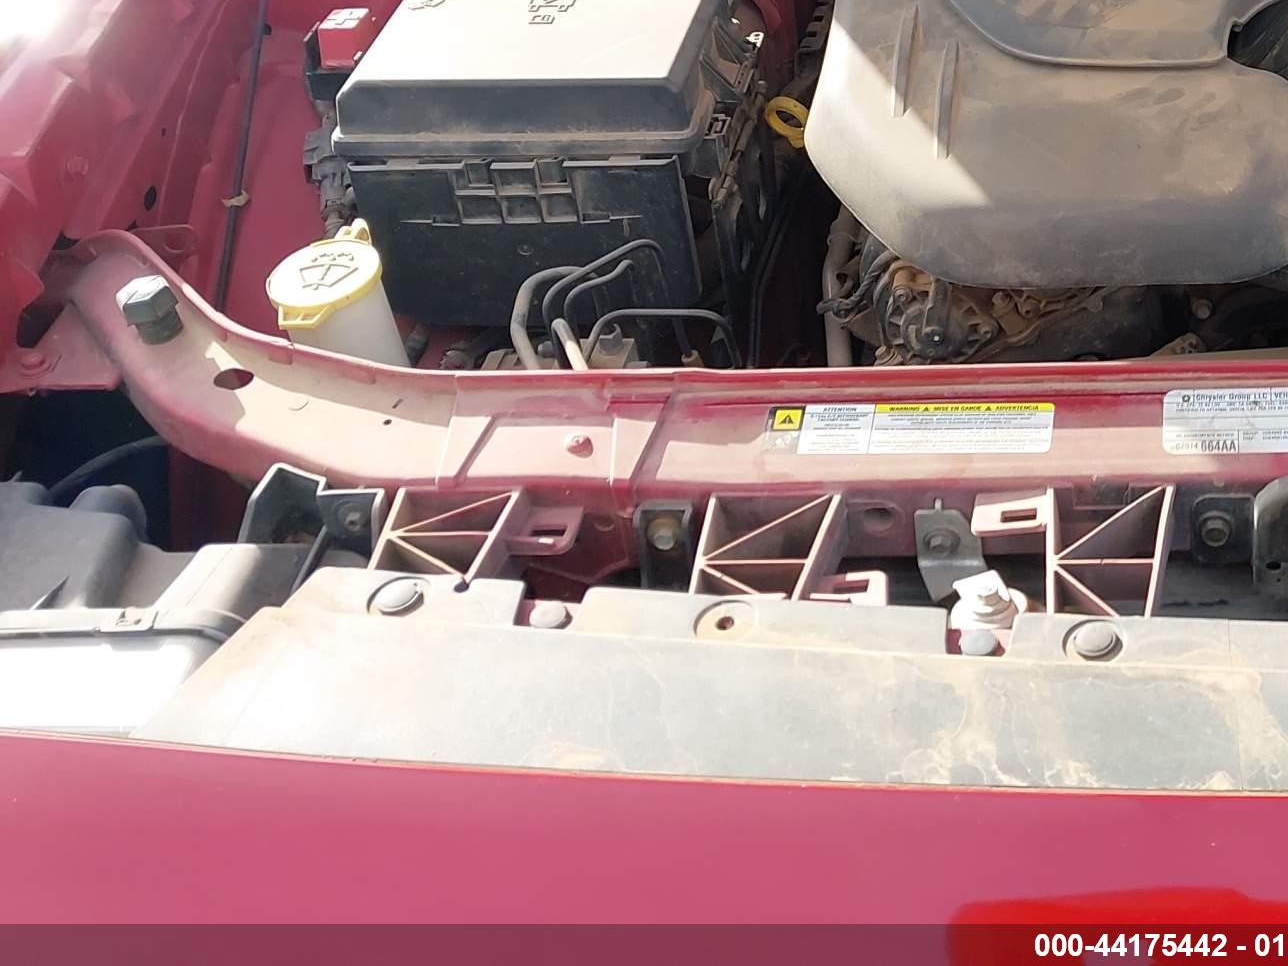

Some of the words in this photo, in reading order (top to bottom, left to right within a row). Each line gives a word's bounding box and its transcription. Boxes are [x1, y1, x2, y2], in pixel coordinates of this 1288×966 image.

[1195, 393, 1226, 403] Chrysler
[1229, 392, 1251, 402] Group
[1253, 392, 1268, 400] LLC
